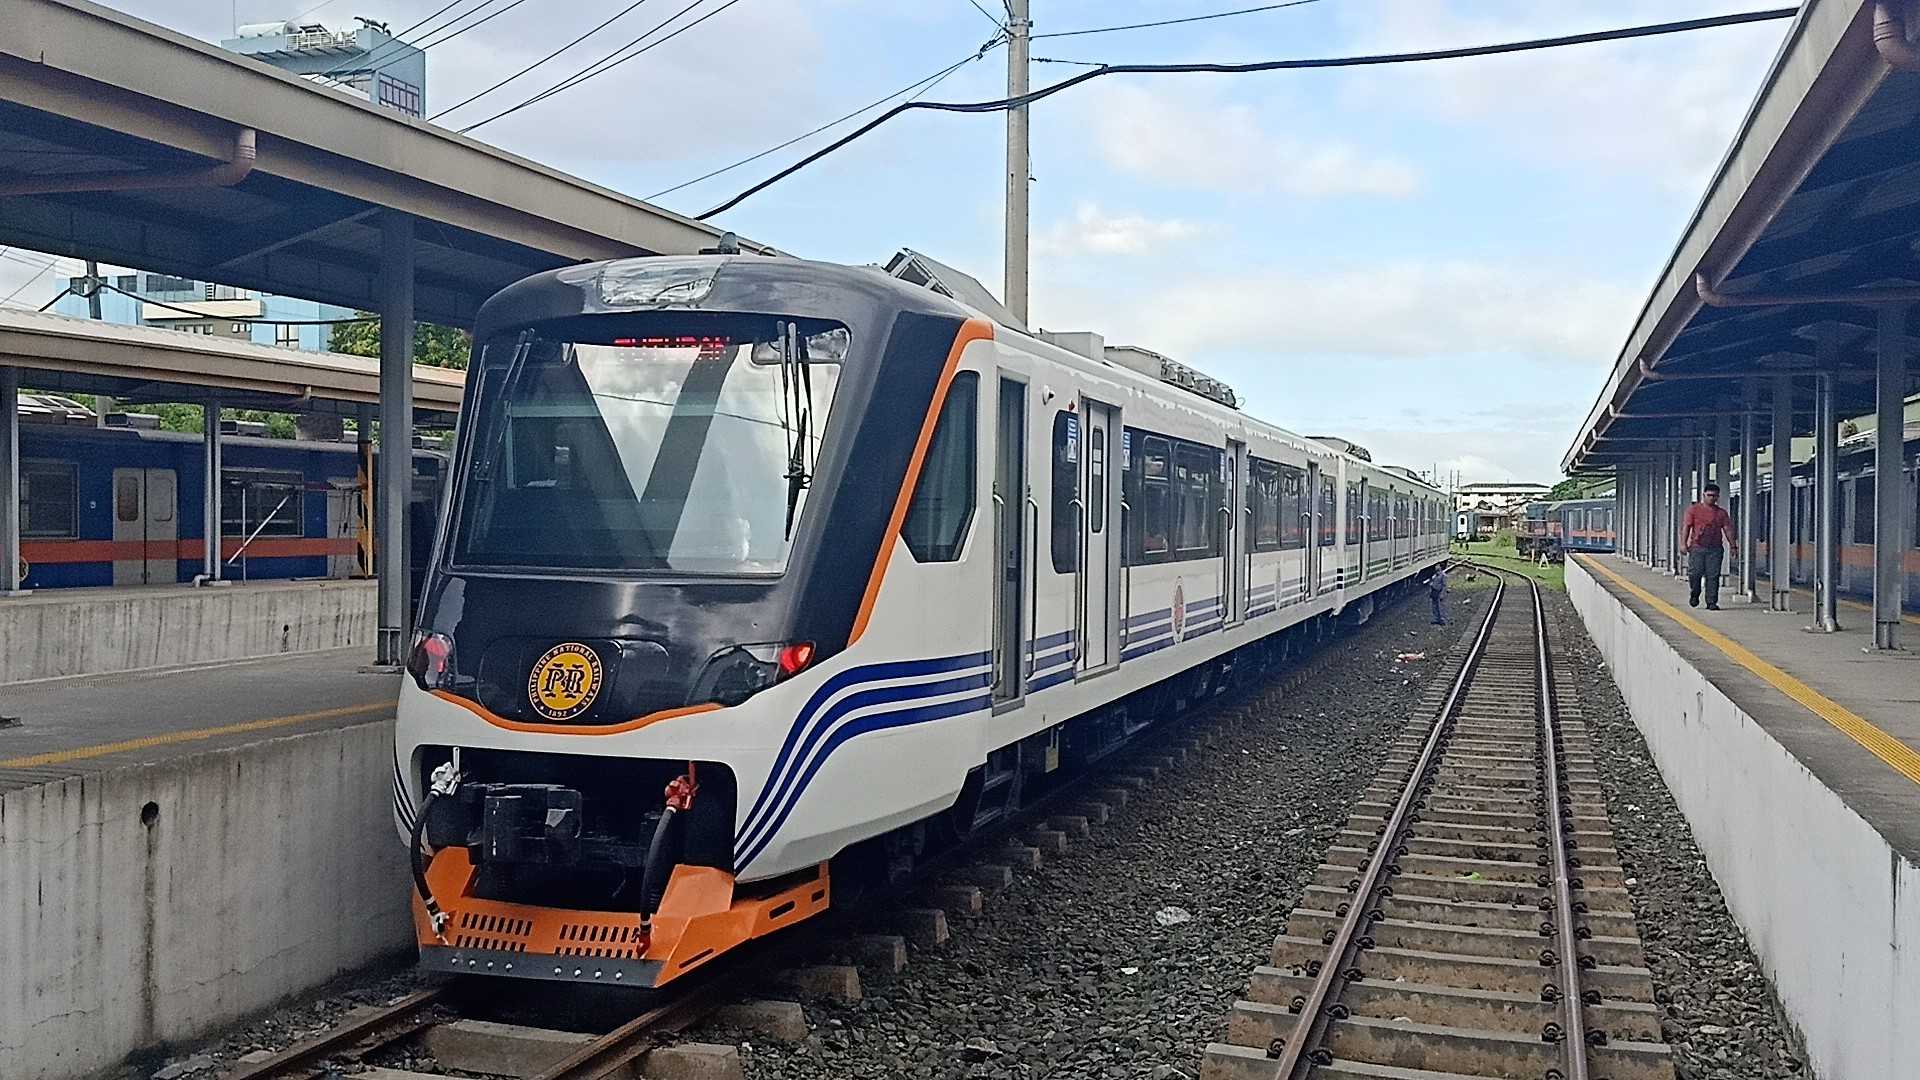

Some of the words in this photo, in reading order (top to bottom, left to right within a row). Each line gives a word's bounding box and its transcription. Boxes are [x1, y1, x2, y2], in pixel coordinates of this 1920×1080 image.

[530, 655, 552, 703] PHILIPPINE
[553, 645, 594, 660] NATIONAL
[581, 661, 600, 706] RAILWAYS
